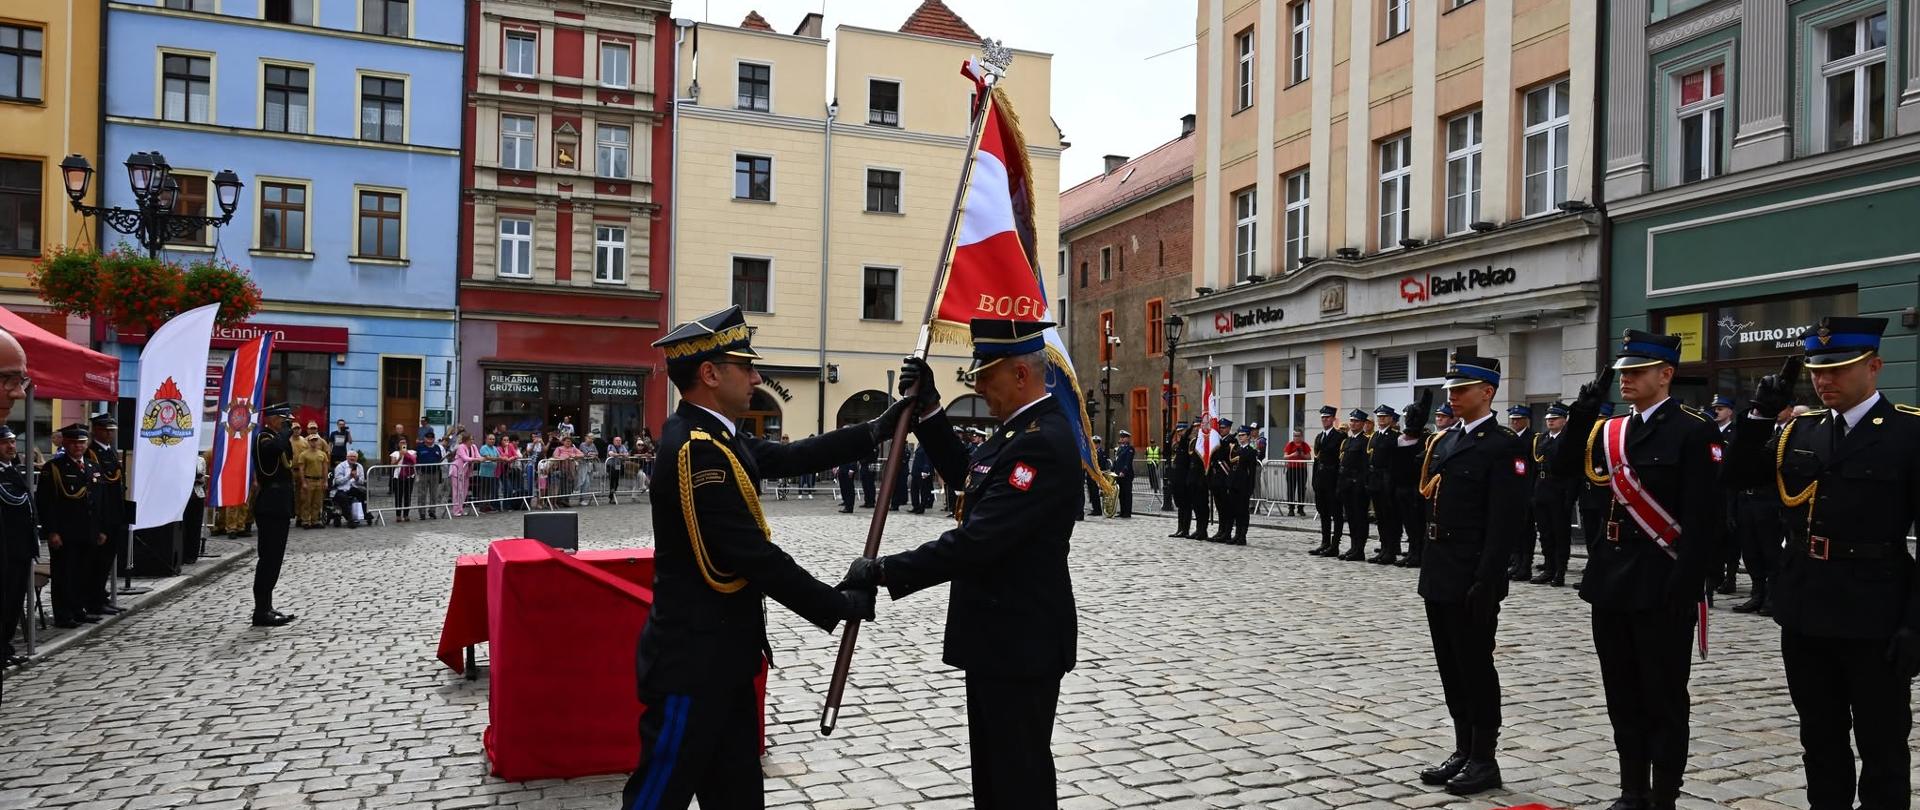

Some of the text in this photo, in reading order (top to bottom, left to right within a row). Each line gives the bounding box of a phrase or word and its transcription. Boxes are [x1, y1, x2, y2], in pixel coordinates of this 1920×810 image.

[1431, 265, 1516, 296] Bank Pekao
[976, 293, 1045, 320] BOGU
[1233, 306, 1284, 328] Bank Pekao
[1739, 325, 1813, 343] BIURO PO
[1775, 340, 1795, 349] Beata
[491, 375, 538, 384] PIEKARNIA
[592, 378, 637, 387] PIEKARNIA
